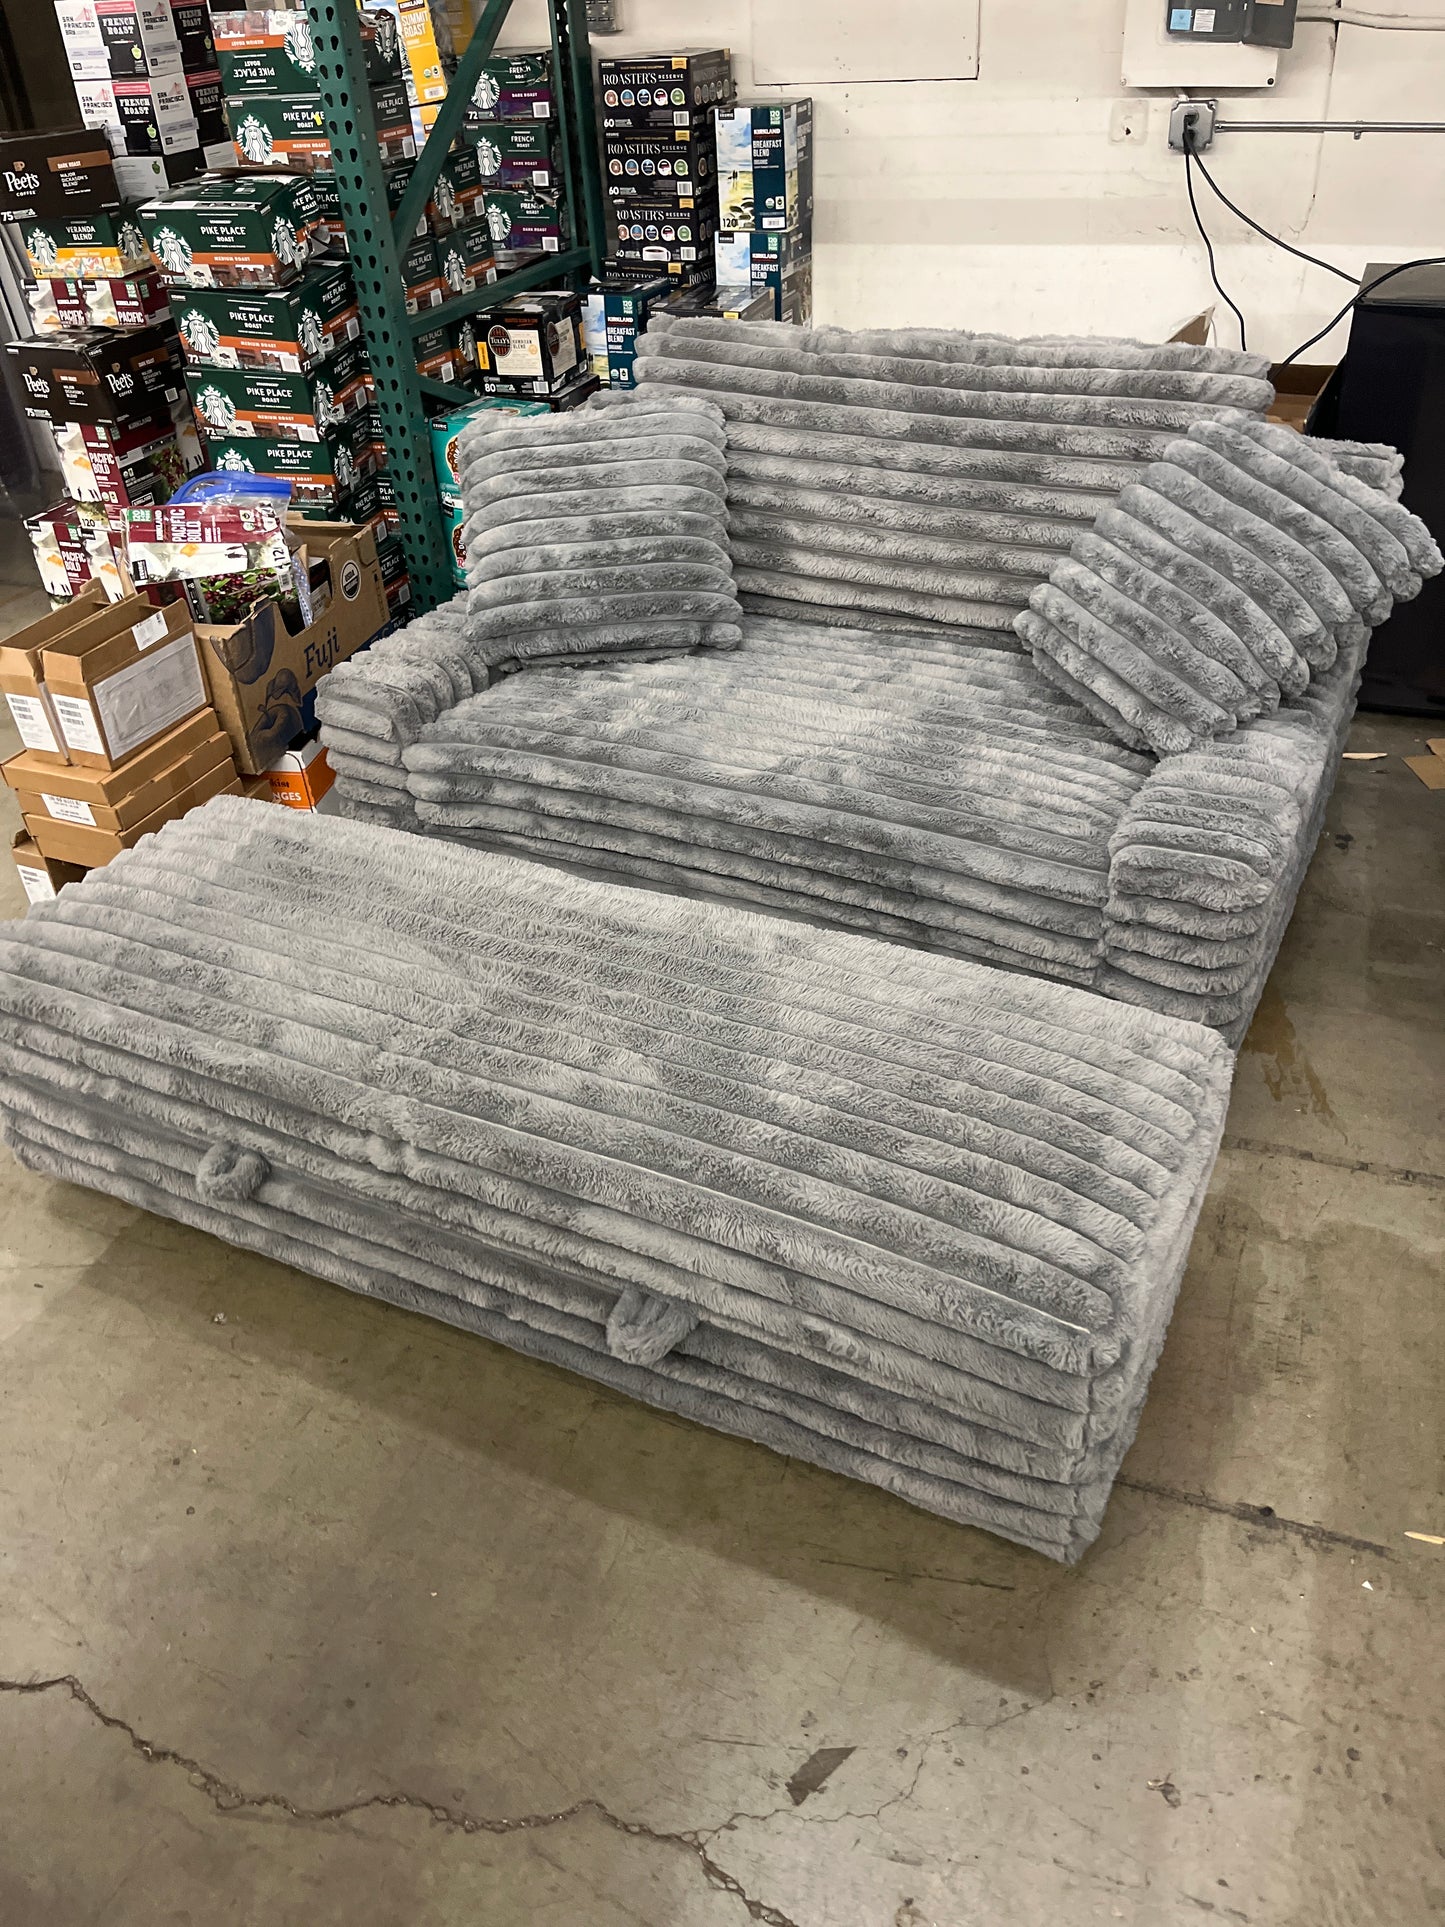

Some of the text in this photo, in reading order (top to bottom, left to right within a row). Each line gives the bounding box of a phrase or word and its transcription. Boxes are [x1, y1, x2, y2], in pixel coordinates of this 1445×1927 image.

[102, 16, 136, 27] FRENCH
[182, 17, 202, 28] ROAST
[401, 12, 429, 25] SUMMIT
[107, 26, 135, 36] ROAST
[403, 23, 426, 38] ROAST
[233, 67, 276, 78] PIKE PLACE
[602, 73, 657, 86] ROASTER'S
[119, 98, 150, 107] FRENCH
[124, 106, 150, 115] ROAST
[467, 111, 479, 120] 72
[282, 111, 300, 121] PIKE
[603, 118, 615, 128] 60
[510, 135, 535, 143] FRENCH
[752, 139, 782, 149] BREAKFAST
[607, 143, 661, 155] ROASTER'S
[752, 148, 770, 158] BLEND
[2, 171, 40, 193] Peet's
[608, 186, 620, 196] 60
[316, 194, 340, 203] PLACE
[0, 211, 14, 222] 75
[722, 218, 738, 228] 120
[65, 226, 96, 234] VERANDA
[200, 226, 246, 236] PIKE PLACE
[72, 233, 93, 241] BLEND
[751, 263, 779, 272] BREAKFAST
[160, 275, 174, 285] 72
[751, 271, 768, 280] BLEND
[332, 282, 347, 296] PLACE
[59, 310, 85, 321] PACIFIC
[117, 312, 144, 323] PACIFIC
[229, 311, 275, 324] PIKE PLACE
[607, 327, 635, 336] BREAKFAST
[607, 334, 624, 343] BLEND
[187, 354, 200, 364] 72
[22, 373, 50, 394] Peet's
[105, 373, 134, 394] Peet's
[484, 383, 496, 392] 80
[246, 387, 293, 398] PIKE PLACE
[24, 407, 35, 417] 75
[203, 426, 216, 436] 72
[88, 452, 115, 465] PACIFIC
[267, 449, 313, 459] PIKE PLACE
[92, 463, 111, 475] BOLD
[81, 519, 96, 527] 120
[170, 508, 187, 543] PACIFIC
[187, 520, 202, 543] BOLD
[61, 551, 86, 563] PACIFIC
[65, 561, 81, 572] BOLD
[303, 626, 341, 679] Fuji
[272, 792, 302, 801] NGES
